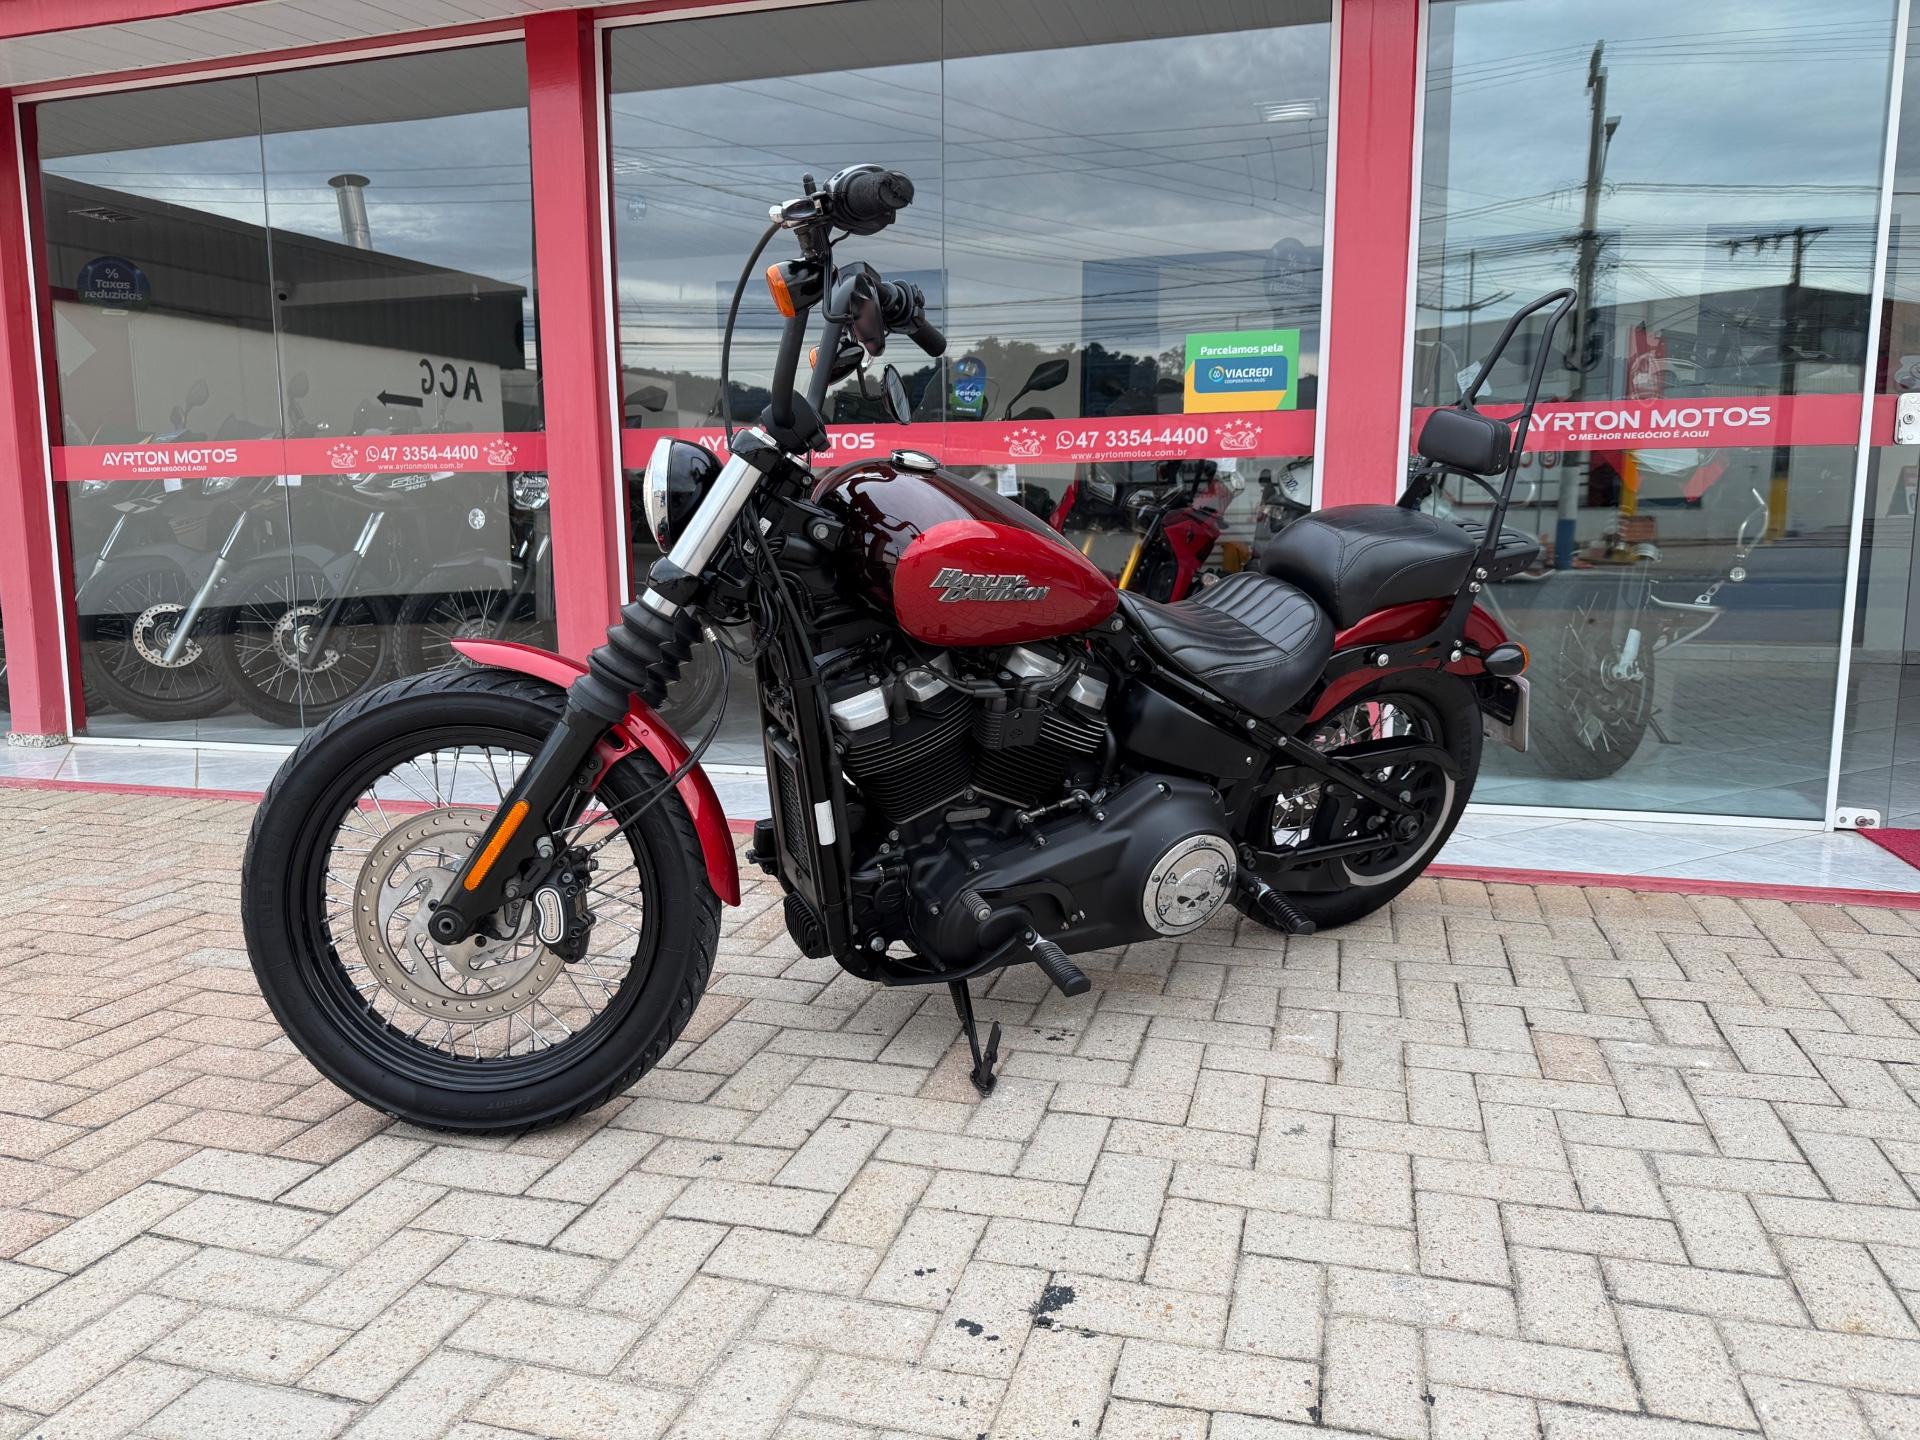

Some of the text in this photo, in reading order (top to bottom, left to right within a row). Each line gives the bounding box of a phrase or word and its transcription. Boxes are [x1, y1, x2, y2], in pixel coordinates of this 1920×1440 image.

[96, 279, 130, 289] Taxas
[84, 290, 143, 301] reduzidas
[1200, 343, 1284, 356] Parcelamos pela
[1225, 367, 1273, 378] VIACREDI
[1651, 407, 1771, 428] MOTOS
[826, 432, 875, 450] TOS
[1075, 427, 1208, 449] 47 3354-4400
[1568, 430, 1710, 441] O MELHOR NEGÓCIO É AQUI
[102, 448, 238, 466] AYRTON MOTOS
[381, 445, 478, 461] 47 3354-4400
[1071, 449, 1187, 460] www.ayrtonmotos.com.br
[161, 465, 187, 473] NEGÓCIO
[378, 462, 464, 471] www.ayrtonmotos.com.br
[938, 586, 1051, 602] DAVIDSON
